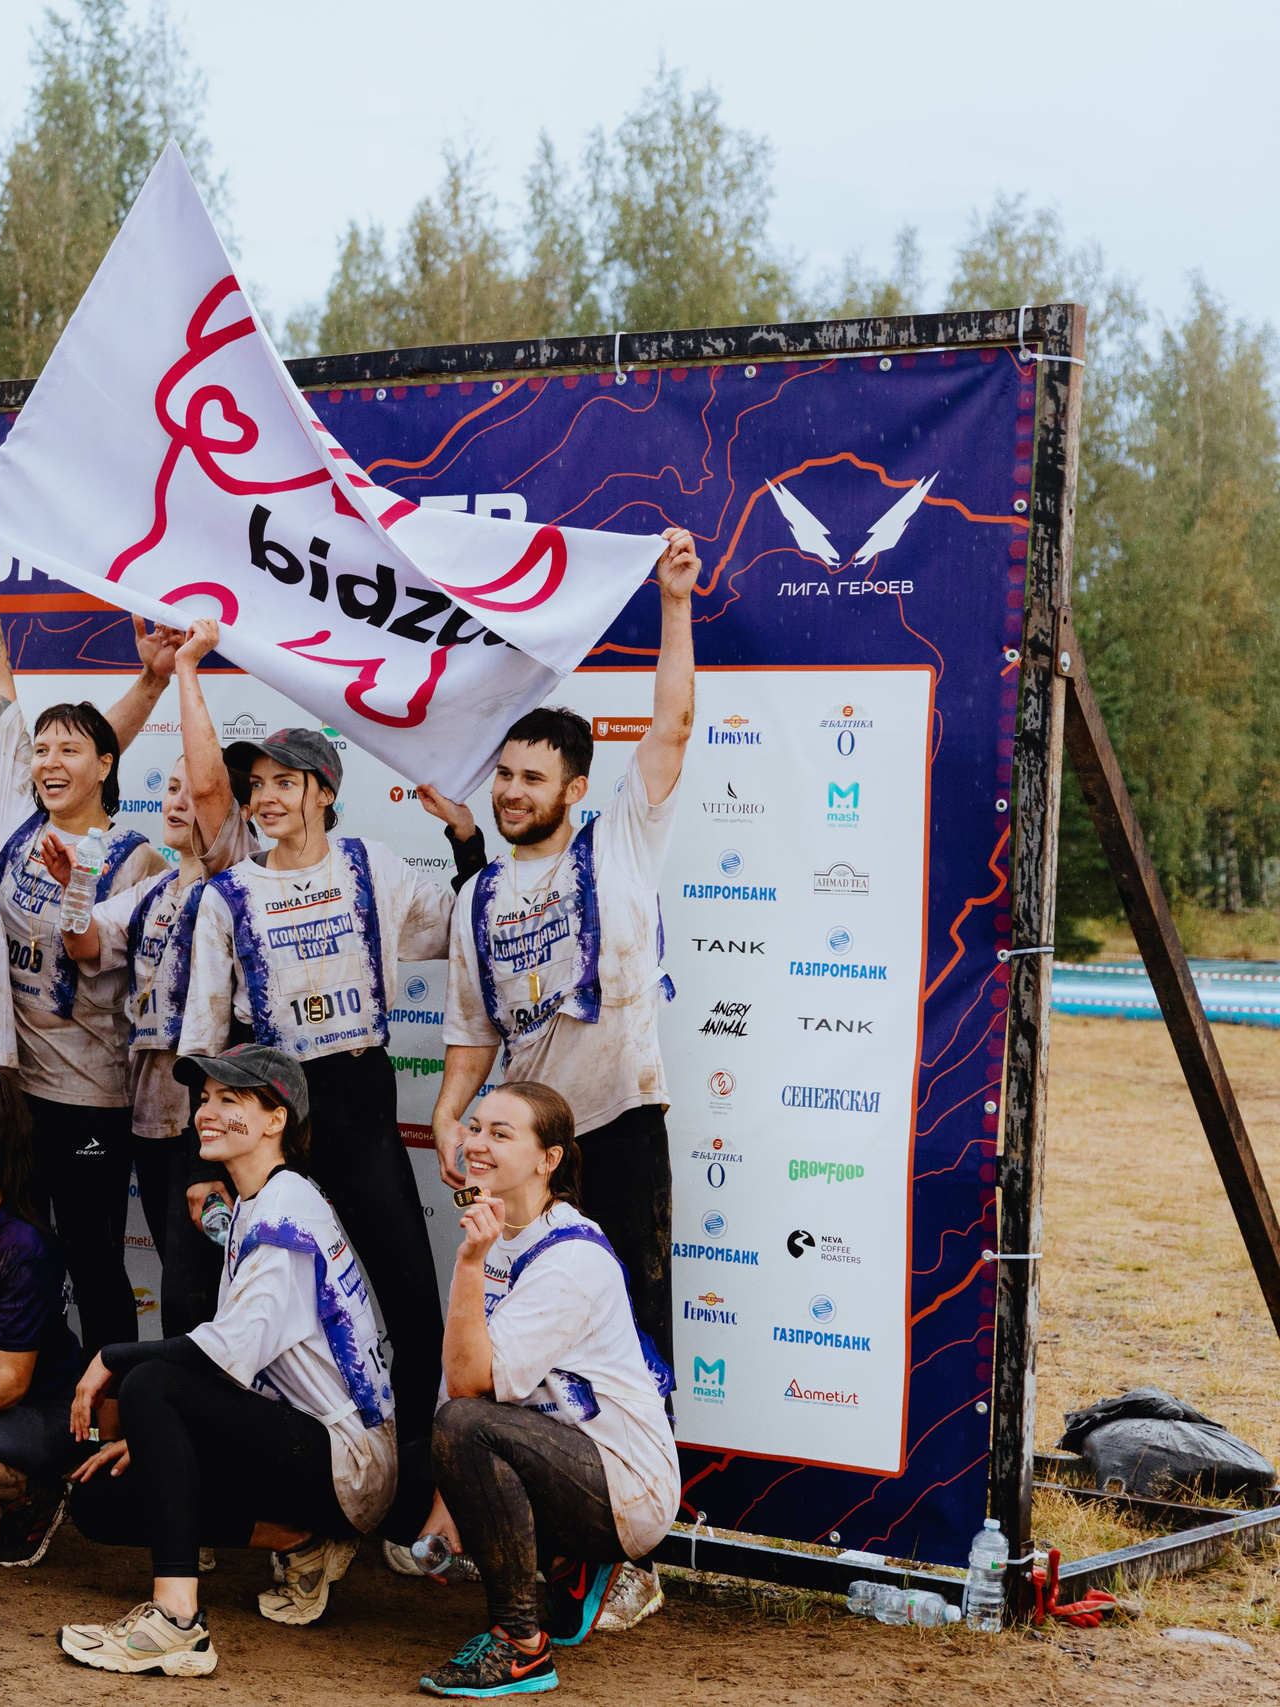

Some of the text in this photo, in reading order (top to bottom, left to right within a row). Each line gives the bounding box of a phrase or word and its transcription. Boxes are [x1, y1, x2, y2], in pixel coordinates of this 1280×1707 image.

[777, 580, 914, 596] ЛИГА ГЕРОЕВ
[609, 724, 651, 733] ЧЕМПИОН
[828, 720, 873, 728] БАЛТИКА
[224, 728, 251, 736] AHMAD
[252, 729, 265, 737] TEA
[119, 800, 162, 813] ГАЗПРОМ
[702, 803, 765, 814] VITTORIO
[827, 811, 860, 822] mash
[816, 878, 867, 888] AHMAD TEA
[265, 887, 342, 911] ГОНКА ГЕРОЕВ
[683, 884, 777, 901] ГАЗПРОМБАНК
[270, 913, 352, 946] КОМАНДНЫЙ
[298, 938, 335, 958] СТАРТ
[691, 938, 766, 954] TANK
[789, 961, 887, 980] ГАЗПРОМБАНК
[710, 1000, 752, 1020] ANGRY
[698, 1018, 748, 1038] ANIMAL
[797, 1016, 874, 1034] TANK
[781, 1085, 881, 1113] СЕНЕЖСКАЯ
[700, 1151, 743, 1163] БАЛТИКА
[788, 1159, 865, 1184] GROWFOOD
[821, 1236, 842, 1244] NEVA
[671, 1242, 760, 1266] АЗПРОМБАНК
[821, 1244, 851, 1254] COFFEE
[821, 1253, 861, 1264] ROASTERS
[485, 1263, 508, 1279] ОНКА
[773, 1327, 870, 1352] ГАЗПРОМБАНК
[693, 1386, 725, 1399] mash
[803, 1389, 859, 1405] ametist
